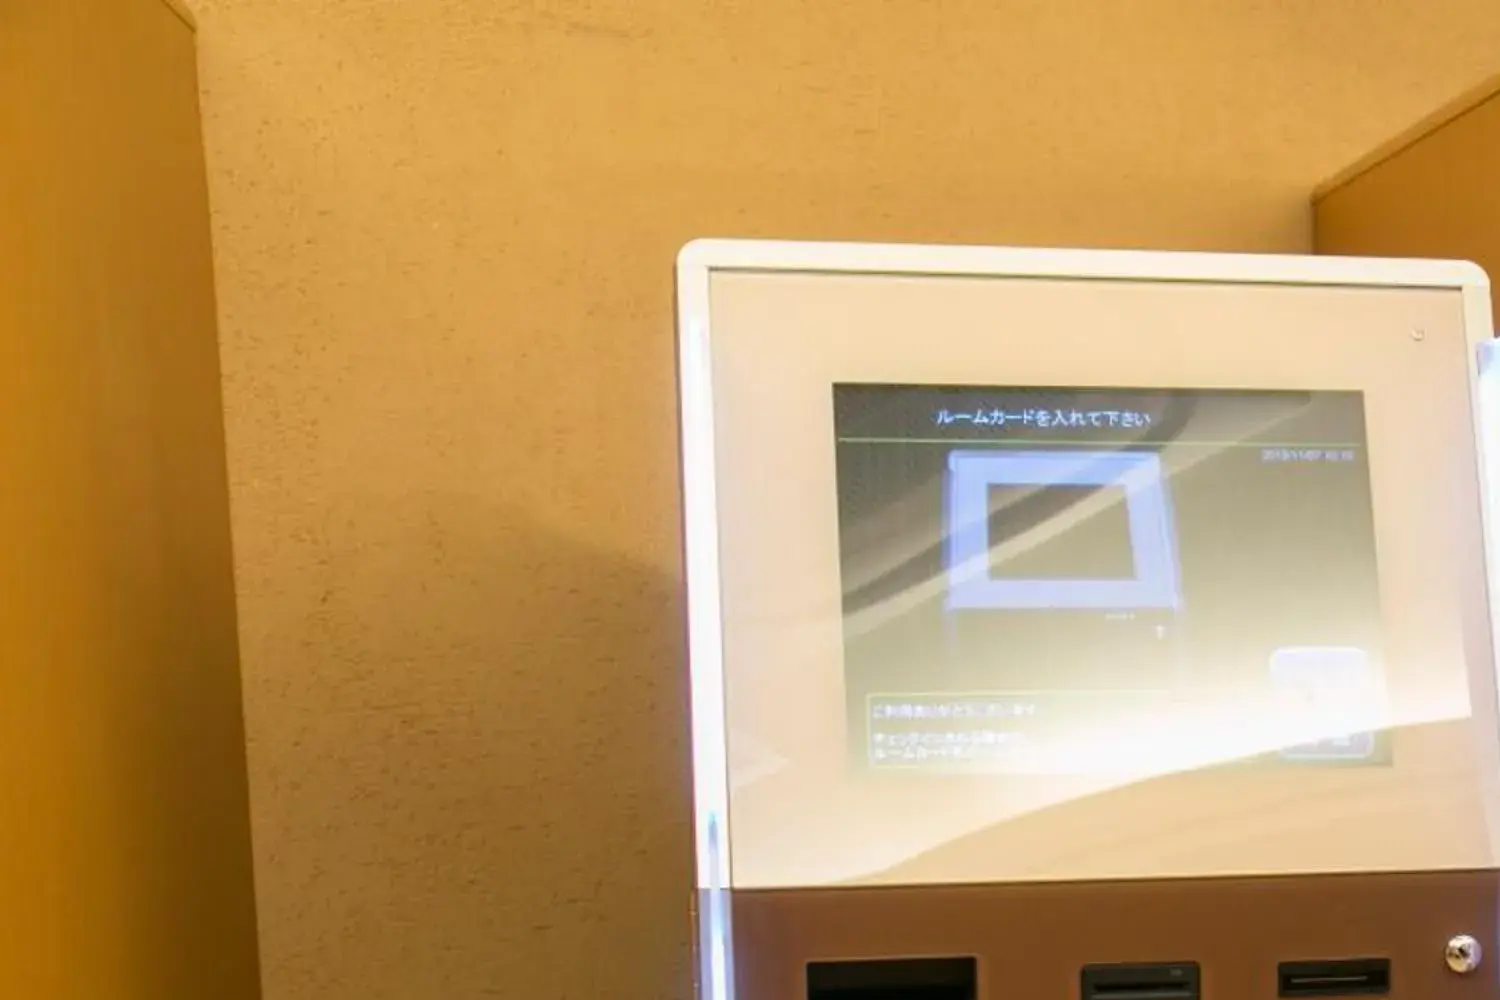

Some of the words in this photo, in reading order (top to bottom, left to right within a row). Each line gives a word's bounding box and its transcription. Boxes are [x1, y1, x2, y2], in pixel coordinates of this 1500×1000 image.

[936, 408, 1152, 428] ルームカードを入れて下さい
